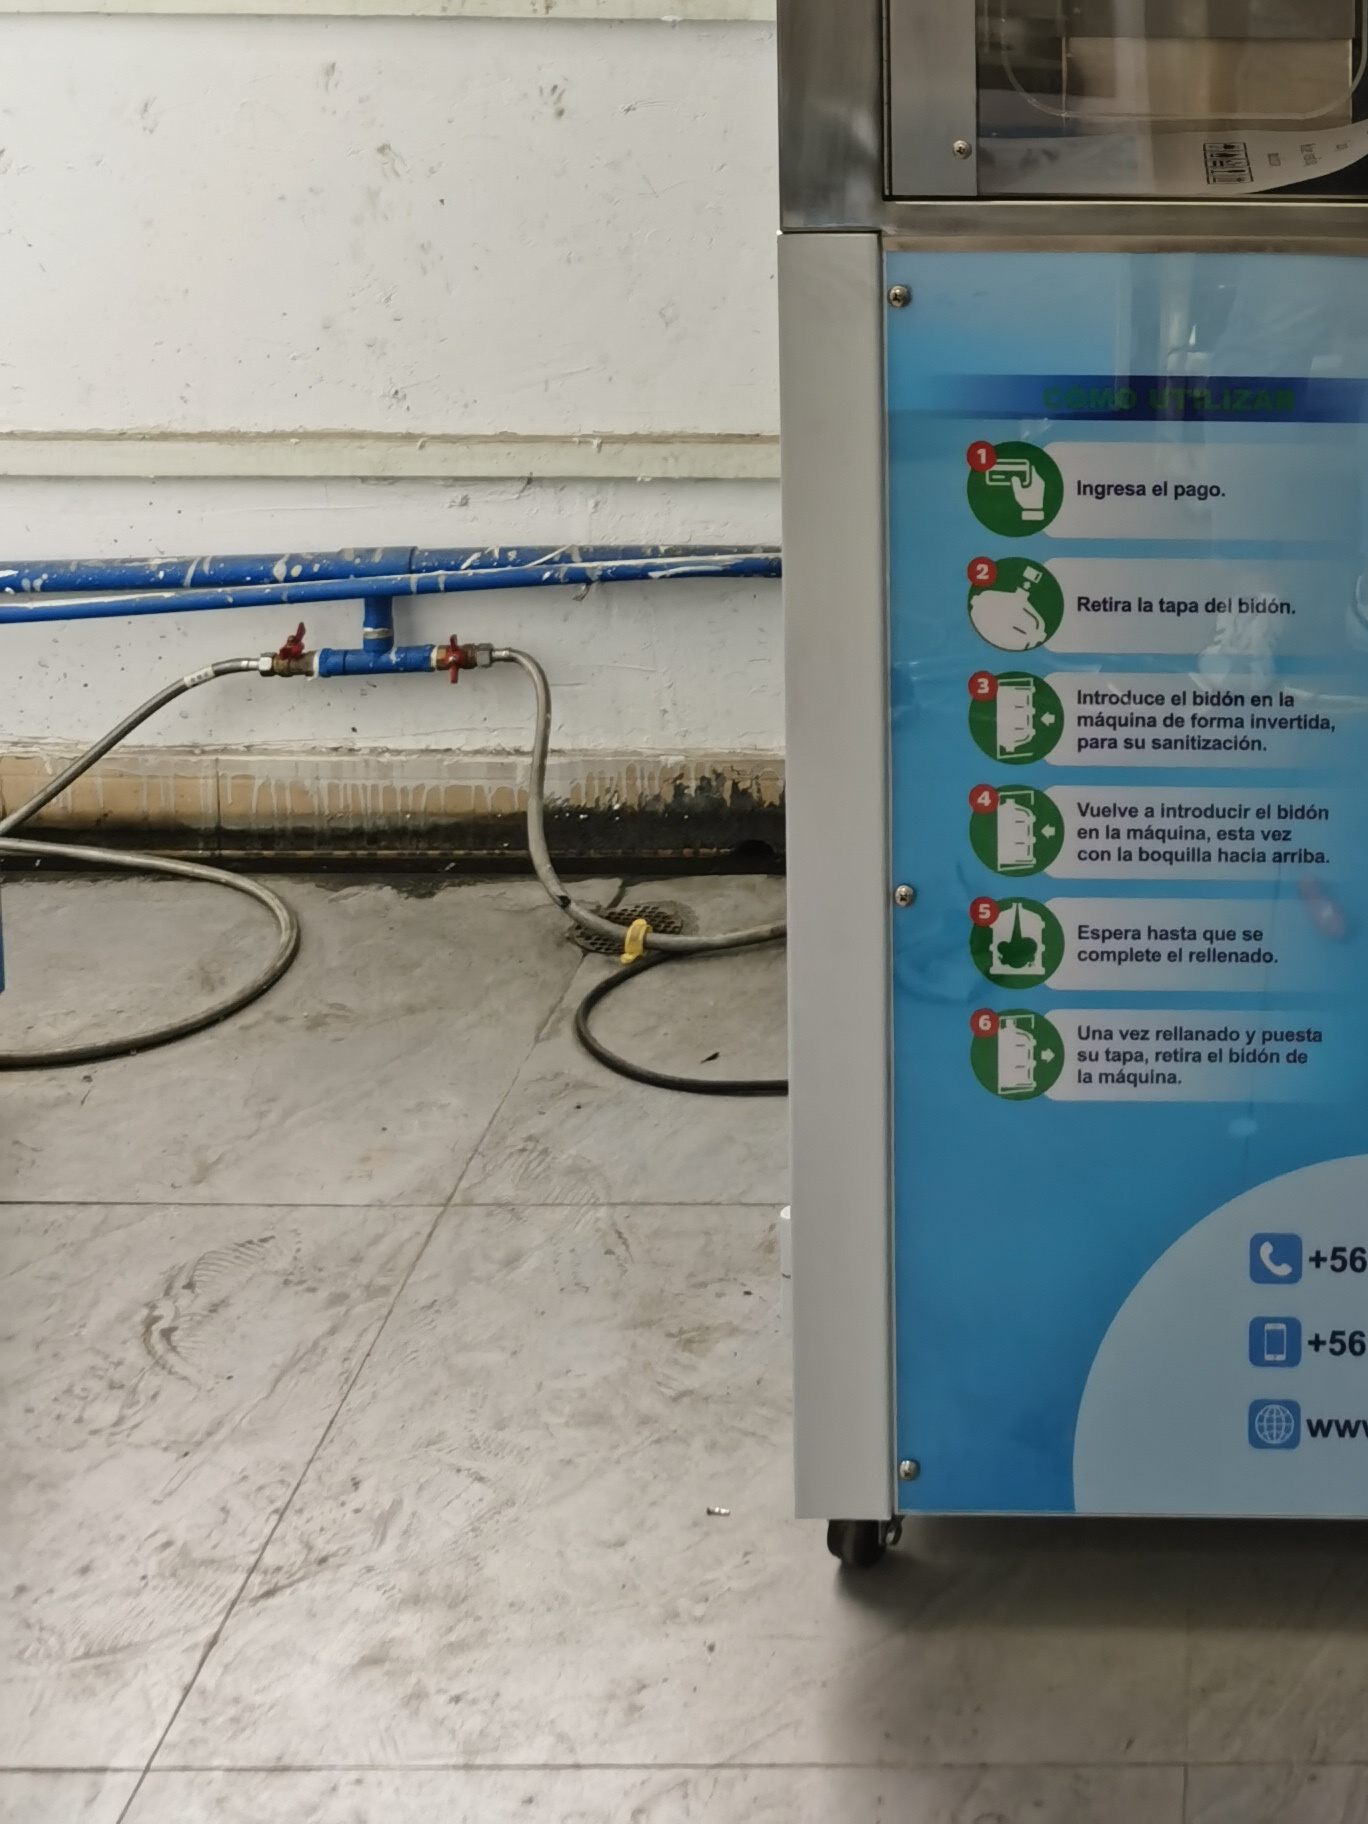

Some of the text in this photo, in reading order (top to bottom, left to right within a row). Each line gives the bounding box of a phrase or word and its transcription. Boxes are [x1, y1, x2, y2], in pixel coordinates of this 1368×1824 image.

[978, 449, 986, 464] 1
[1077, 480, 1225, 500] Ingresa el pago.
[977, 565, 989, 579] 2
[1078, 597, 1295, 616] Retira la tapa del bidón.
[978, 679, 989, 693] 3
[1078, 690, 1294, 707] Introduce el bidón en la
[1077, 712, 1335, 732] máquina de forma invertida,
[1078, 735, 1266, 752] para su sanitización.
[978, 792, 991, 806] 4
[1077, 802, 1328, 820] Vuelve a introducir el bidón
[1077, 825, 1291, 843] en la máquina, esta vez
[1078, 847, 1329, 865] con la boquilla hacia arriba.
[979, 904, 990, 918] 5
[1078, 925, 1263, 944] Espera hasta que se
[1078, 947, 1277, 965] complete el rellenado.
[979, 1015, 991, 1030] 6
[1078, 1026, 1322, 1045] Una vez rellanado y puesta
[1078, 1048, 1307, 1065] su tapa, retira el bidón de
[1078, 1069, 1181, 1087] la máquina.
[1309, 1247, 1367, 1273] +56
[1308, 1330, 1366, 1356] +56
